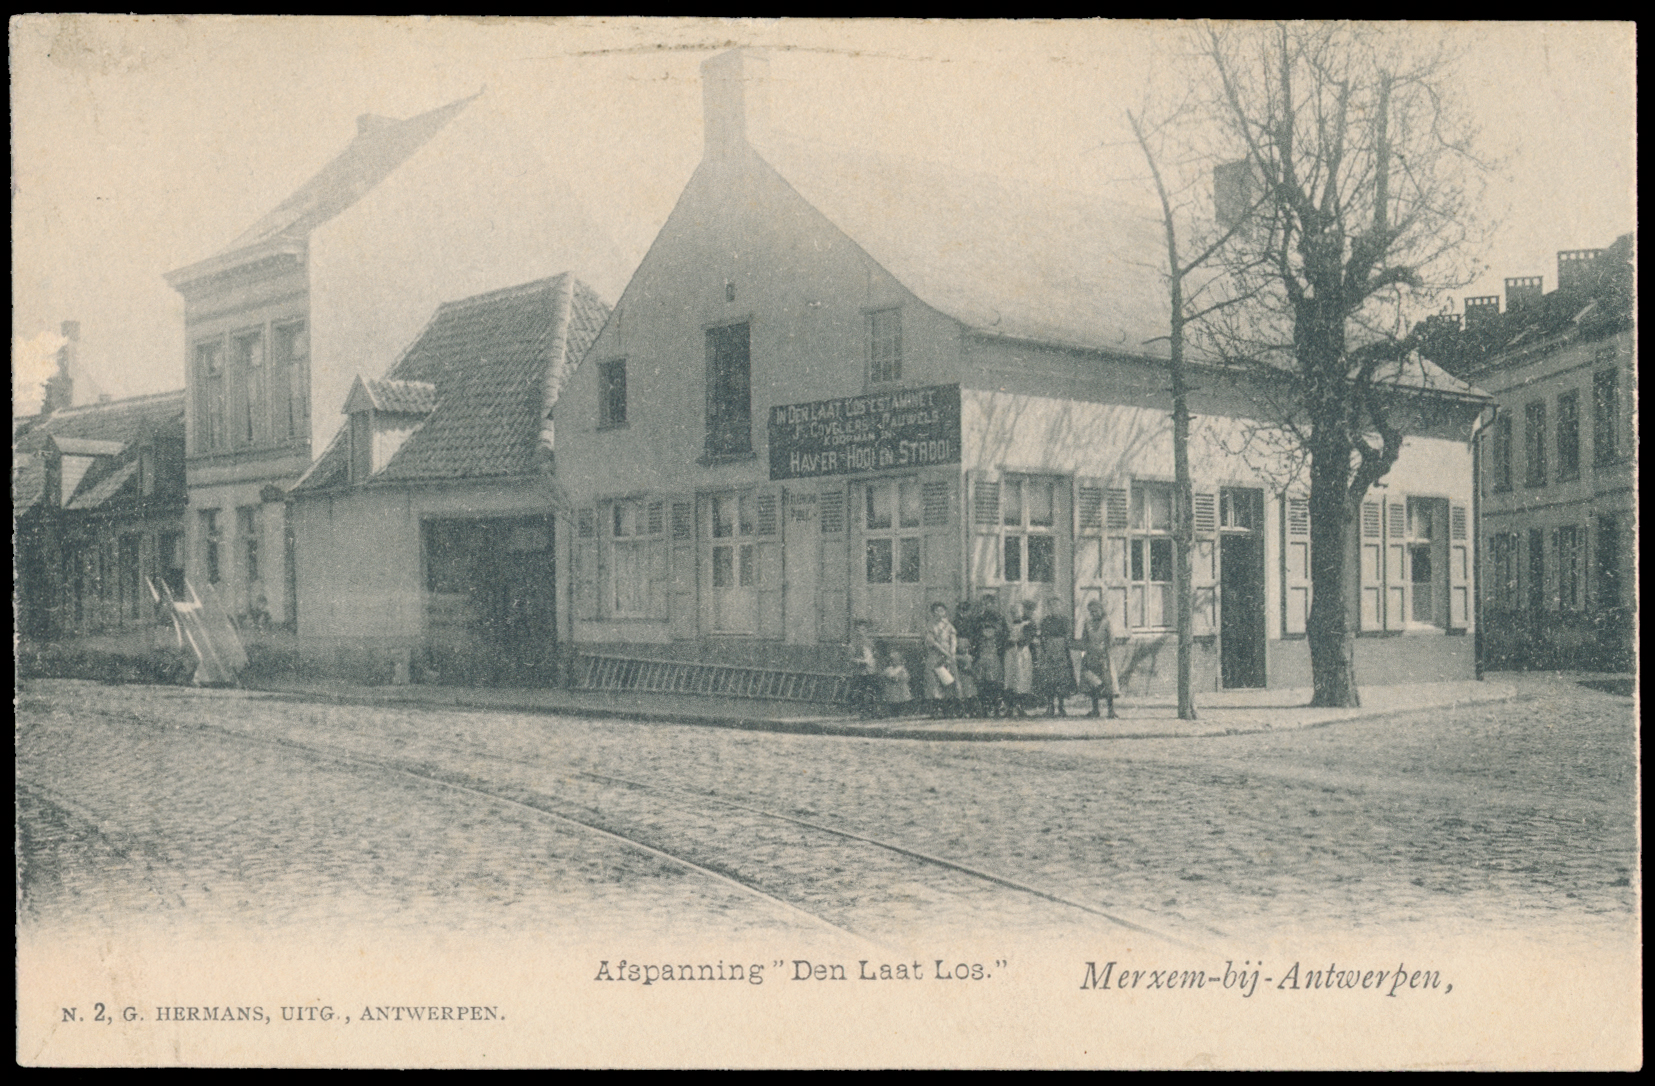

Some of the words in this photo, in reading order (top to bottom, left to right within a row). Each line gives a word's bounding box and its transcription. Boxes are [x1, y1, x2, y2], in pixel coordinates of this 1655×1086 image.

[788, 405, 809, 424] DEN
[811, 402, 842, 421] LAAT
[845, 398, 866, 416] LOS
[790, 450, 837, 473] HAVER
[879, 448, 894, 466] EN
